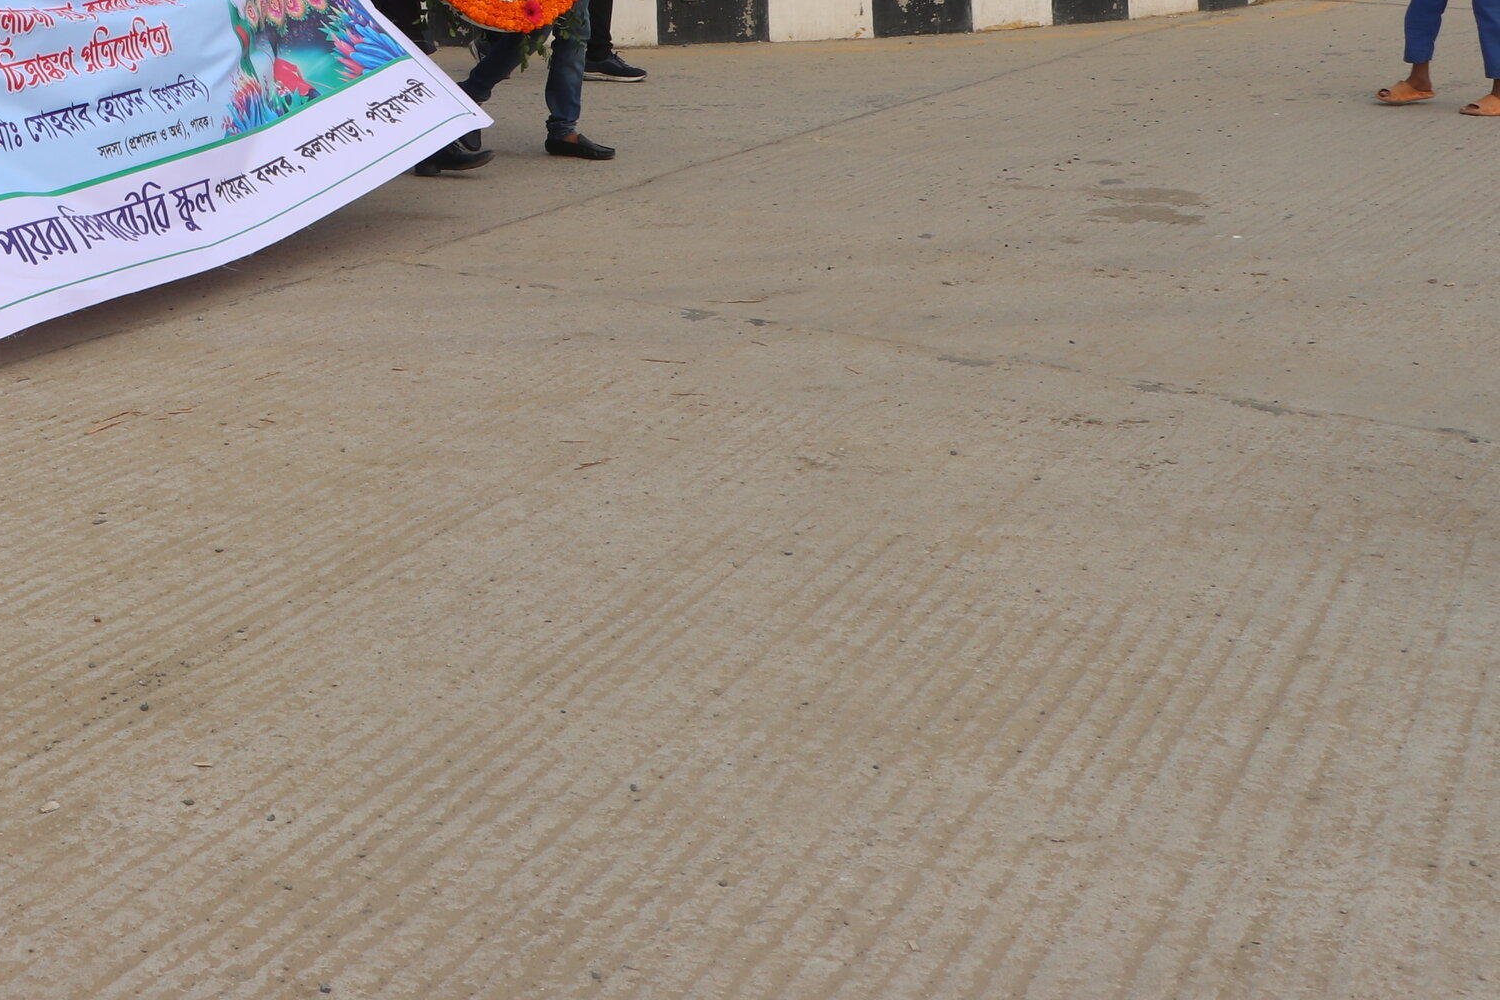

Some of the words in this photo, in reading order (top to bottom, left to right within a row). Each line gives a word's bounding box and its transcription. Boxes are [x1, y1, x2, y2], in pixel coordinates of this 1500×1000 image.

[80, 16, 174, 74] প্রতিযোগিতা
[24, 101, 98, 143] সোহরাব
[96, 87, 153, 125] হোসেন
[96, 141, 123, 160] সদস্য
[124, 131, 160, 157] (প্রশাসন
[160, 129, 168, 141] ও
[167, 118, 191, 141] অর্থ),
[57, 181, 171, 250] প্রিপারেটরি
[168, 178, 217, 232] স্কুল
[214, 171, 259, 205] পায়রা
[249, 155, 306, 187] বন্দর,
[293, 117, 375, 161] কলাপাড়া,
[365, 77, 438, 125] পটুয়াখালী
